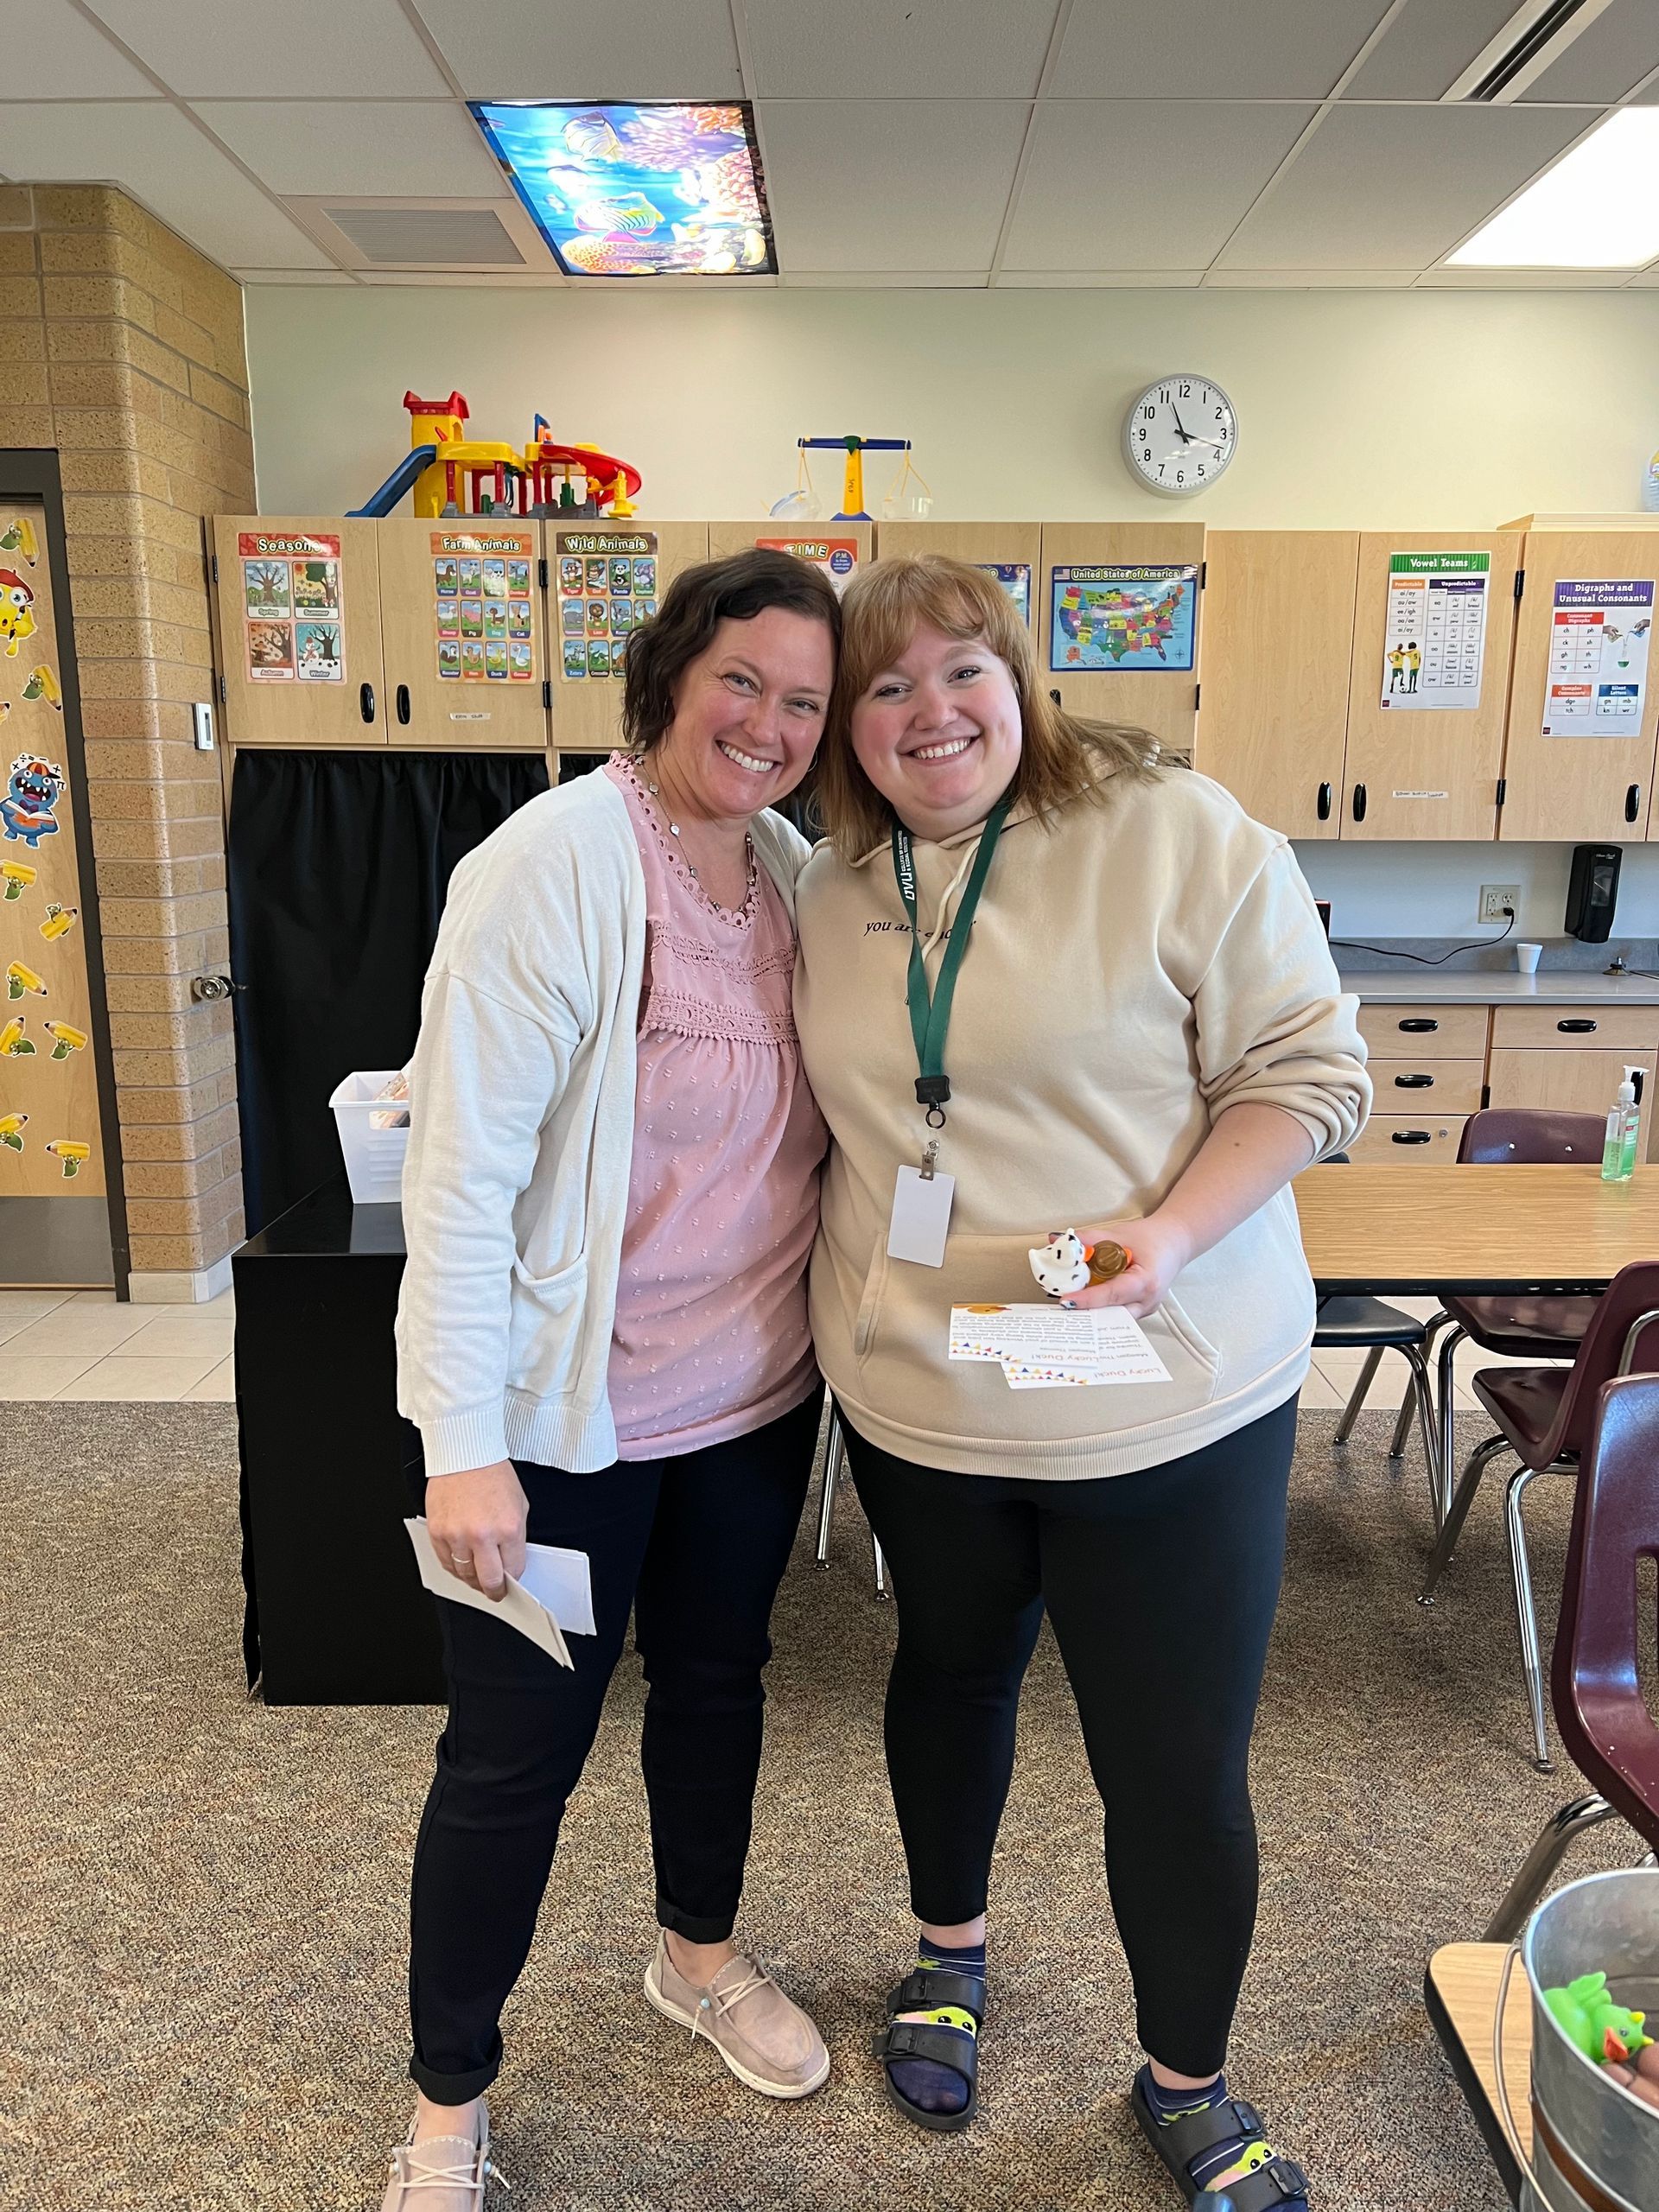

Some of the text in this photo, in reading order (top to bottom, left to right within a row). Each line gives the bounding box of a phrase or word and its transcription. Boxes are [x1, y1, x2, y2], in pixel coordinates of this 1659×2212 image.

[1179, 385, 1191, 397] 12
[1160, 391, 1169, 404] 11
[1204, 391, 1206, 404] 1
[1144, 406, 1155, 419] 10
[1215, 407, 1222, 420] 2
[1140, 429, 1146, 441] 9
[1220, 428, 1227, 440] 3
[1144, 448, 1151, 461] 8
[1213, 449, 1220, 461] 4
[1158, 464, 1165, 477] 7
[1177, 470, 1184, 482] 6
[1198, 464, 1205, 476] 5
[443, 537, 520, 551] Farm Animals
[567, 537, 646, 551] Wild Animals
[786, 544, 828, 557] TIME
[1410, 558, 1468, 567] Vowel Teams
[1073, 569, 1179, 579] United States of America
[1574, 583, 1633, 594] Digraphs and
[863, 921, 892, 937] you
[1094, 1370, 1127, 1378] Duck!
